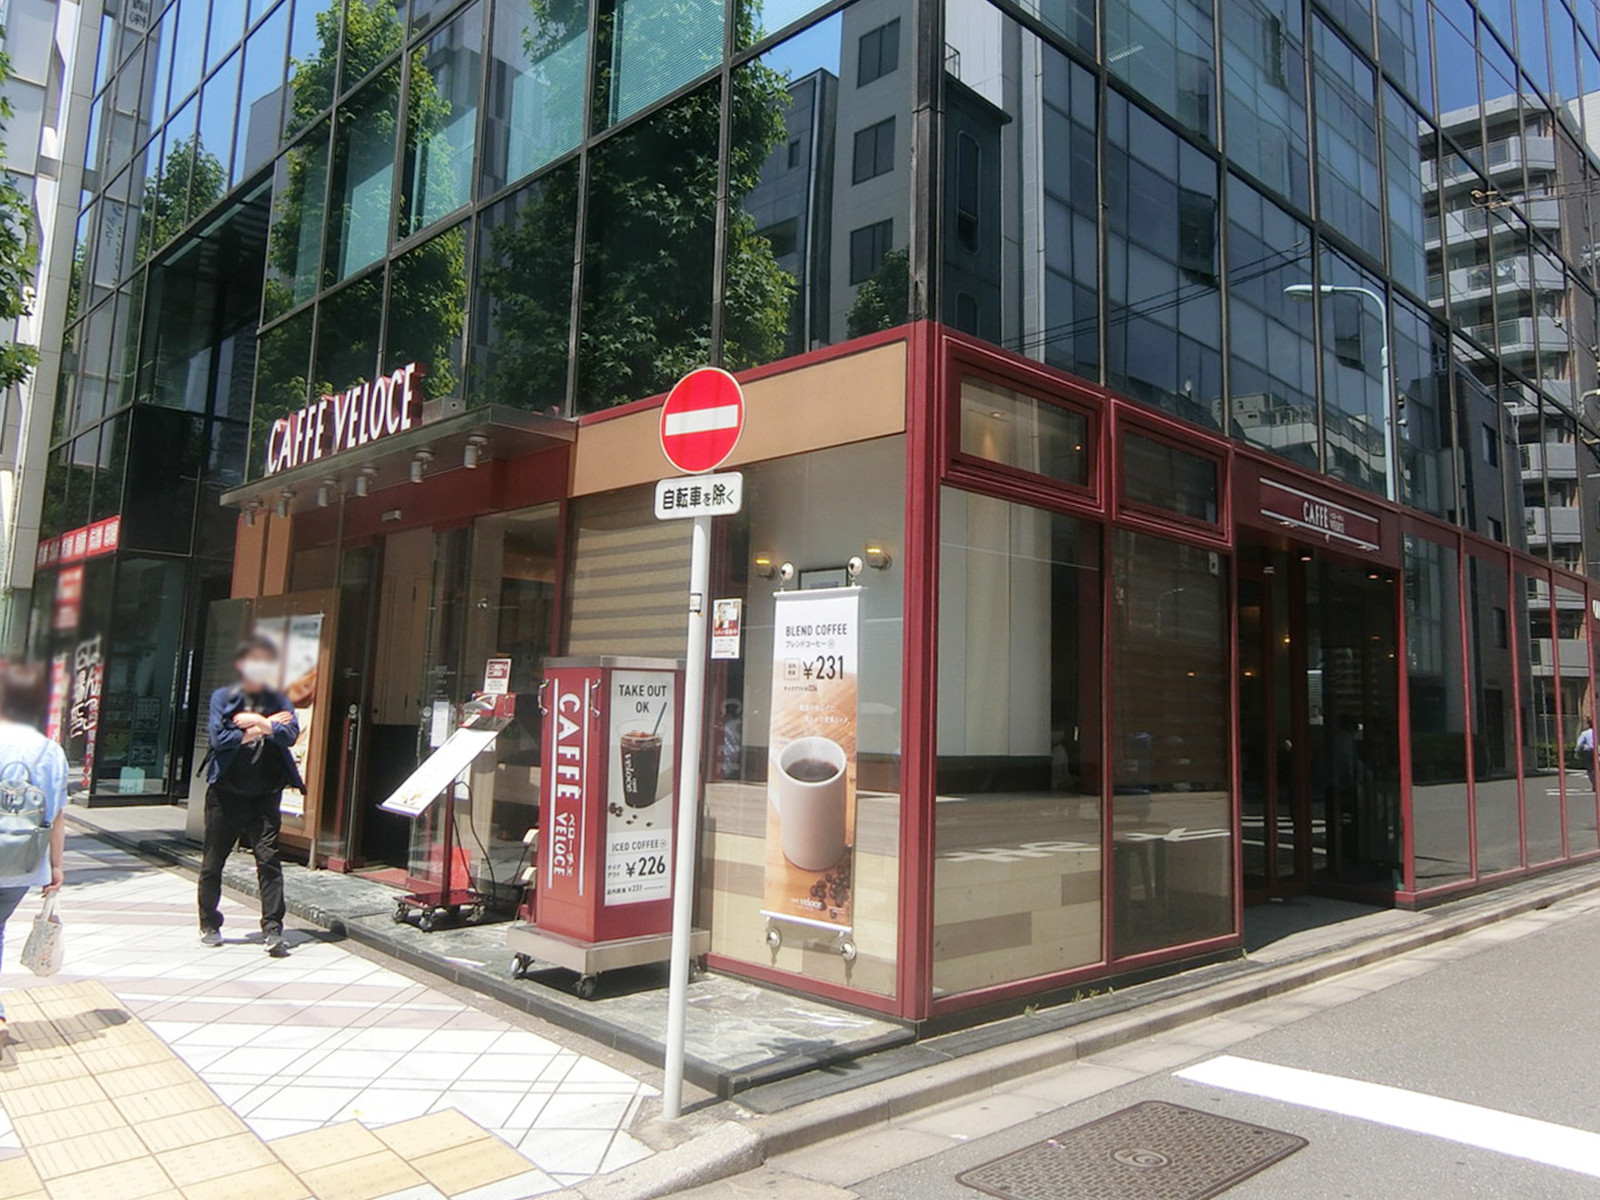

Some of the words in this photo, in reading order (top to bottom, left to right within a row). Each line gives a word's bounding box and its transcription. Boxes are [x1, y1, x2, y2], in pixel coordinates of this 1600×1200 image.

[333, 362, 416, 451] VELOCE
[663, 483, 734, 510] 自転車を除く
[785, 625, 813, 637] BLEND
[815, 623, 847, 636] COFFEE
[785, 640, 826, 648] ブレンドコーヒー
[802, 655, 844, 680] ¥231
[619, 684, 645, 697] TAKE
[647, 684, 667, 697] OUT
[635, 701, 650, 713] OK
[553, 812, 568, 877] VELOCE
[611, 842, 630, 852] ICED
[632, 839, 659, 850] COFFEE
[625, 854, 666, 877] ¥226
